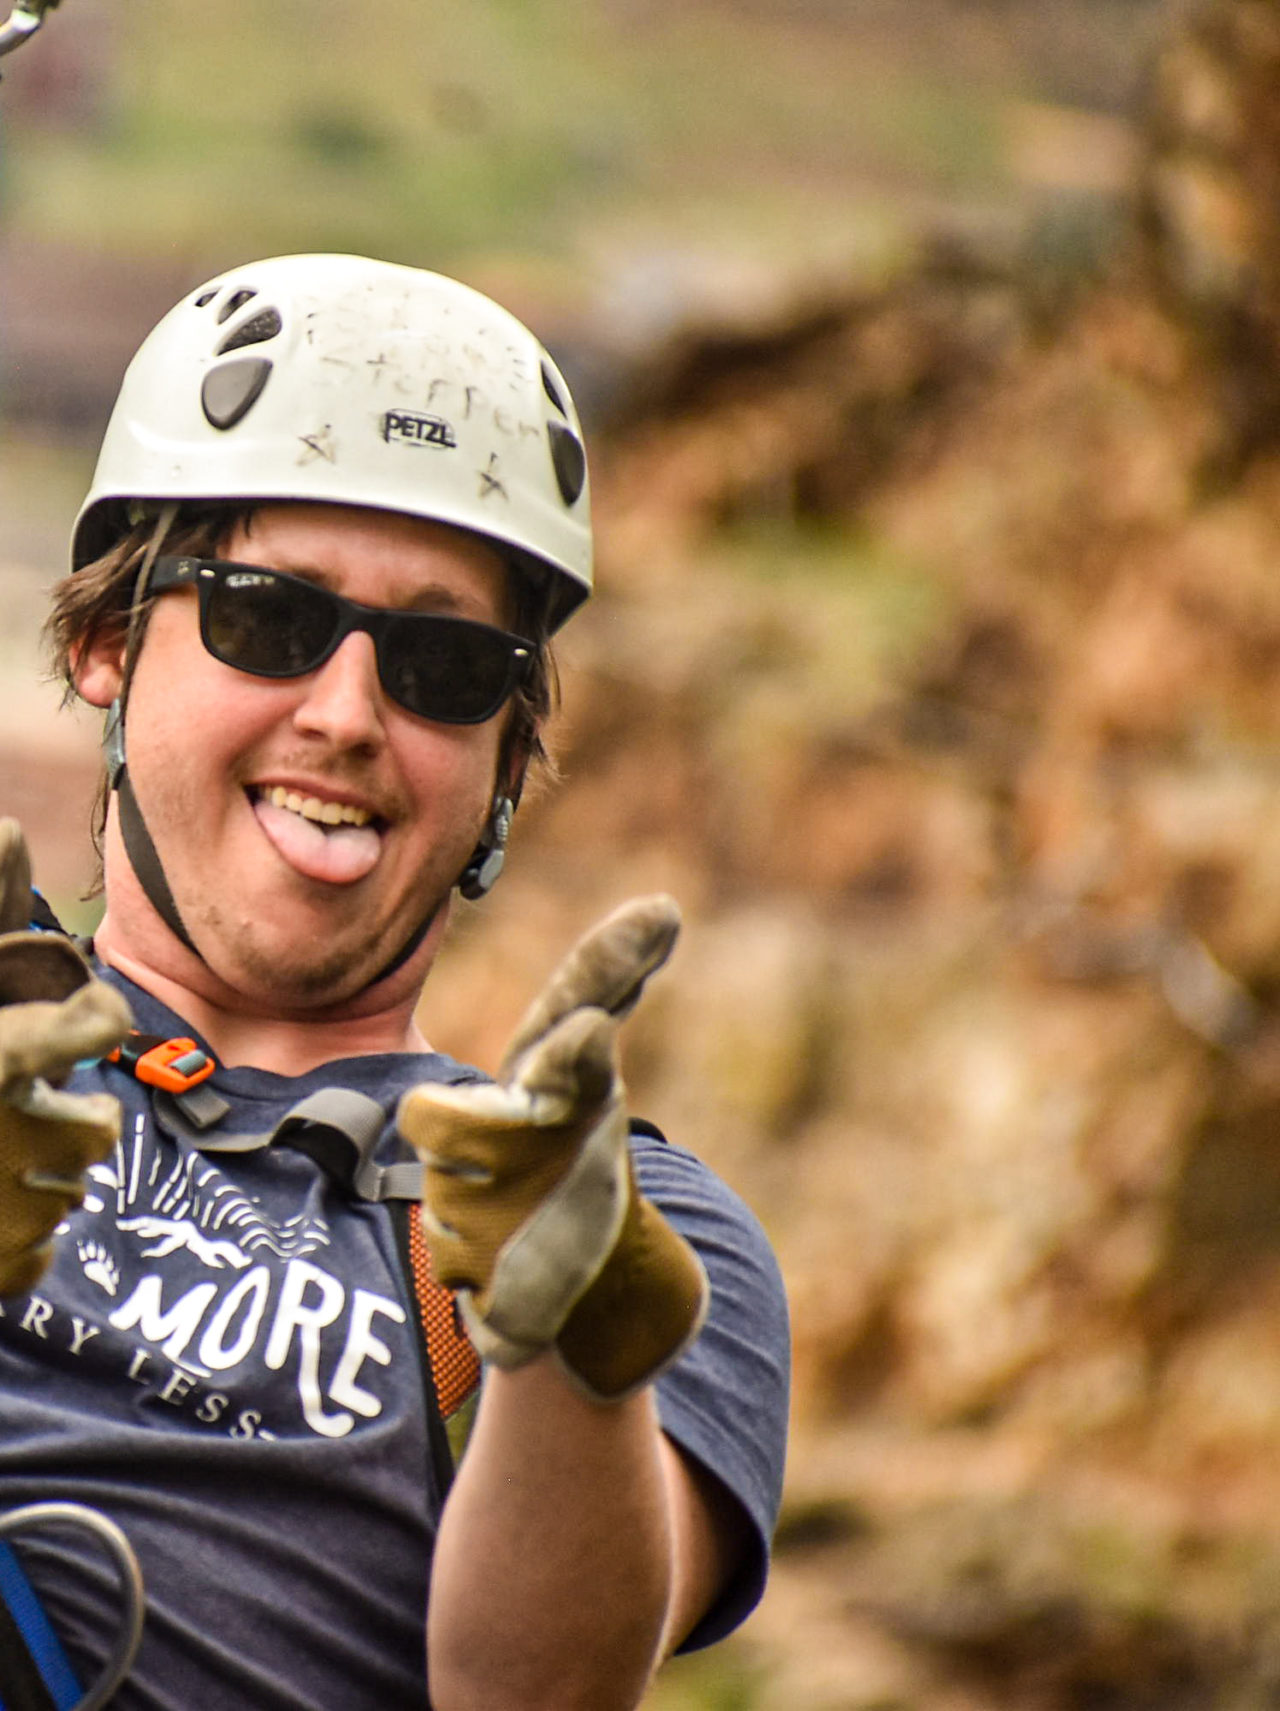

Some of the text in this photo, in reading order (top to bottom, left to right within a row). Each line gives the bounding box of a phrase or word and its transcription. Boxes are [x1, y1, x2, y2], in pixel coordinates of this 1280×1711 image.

[383, 412, 457, 448] PETZL
[108, 1257, 406, 1438] MORE
[128, 1348, 262, 1441] LESS
